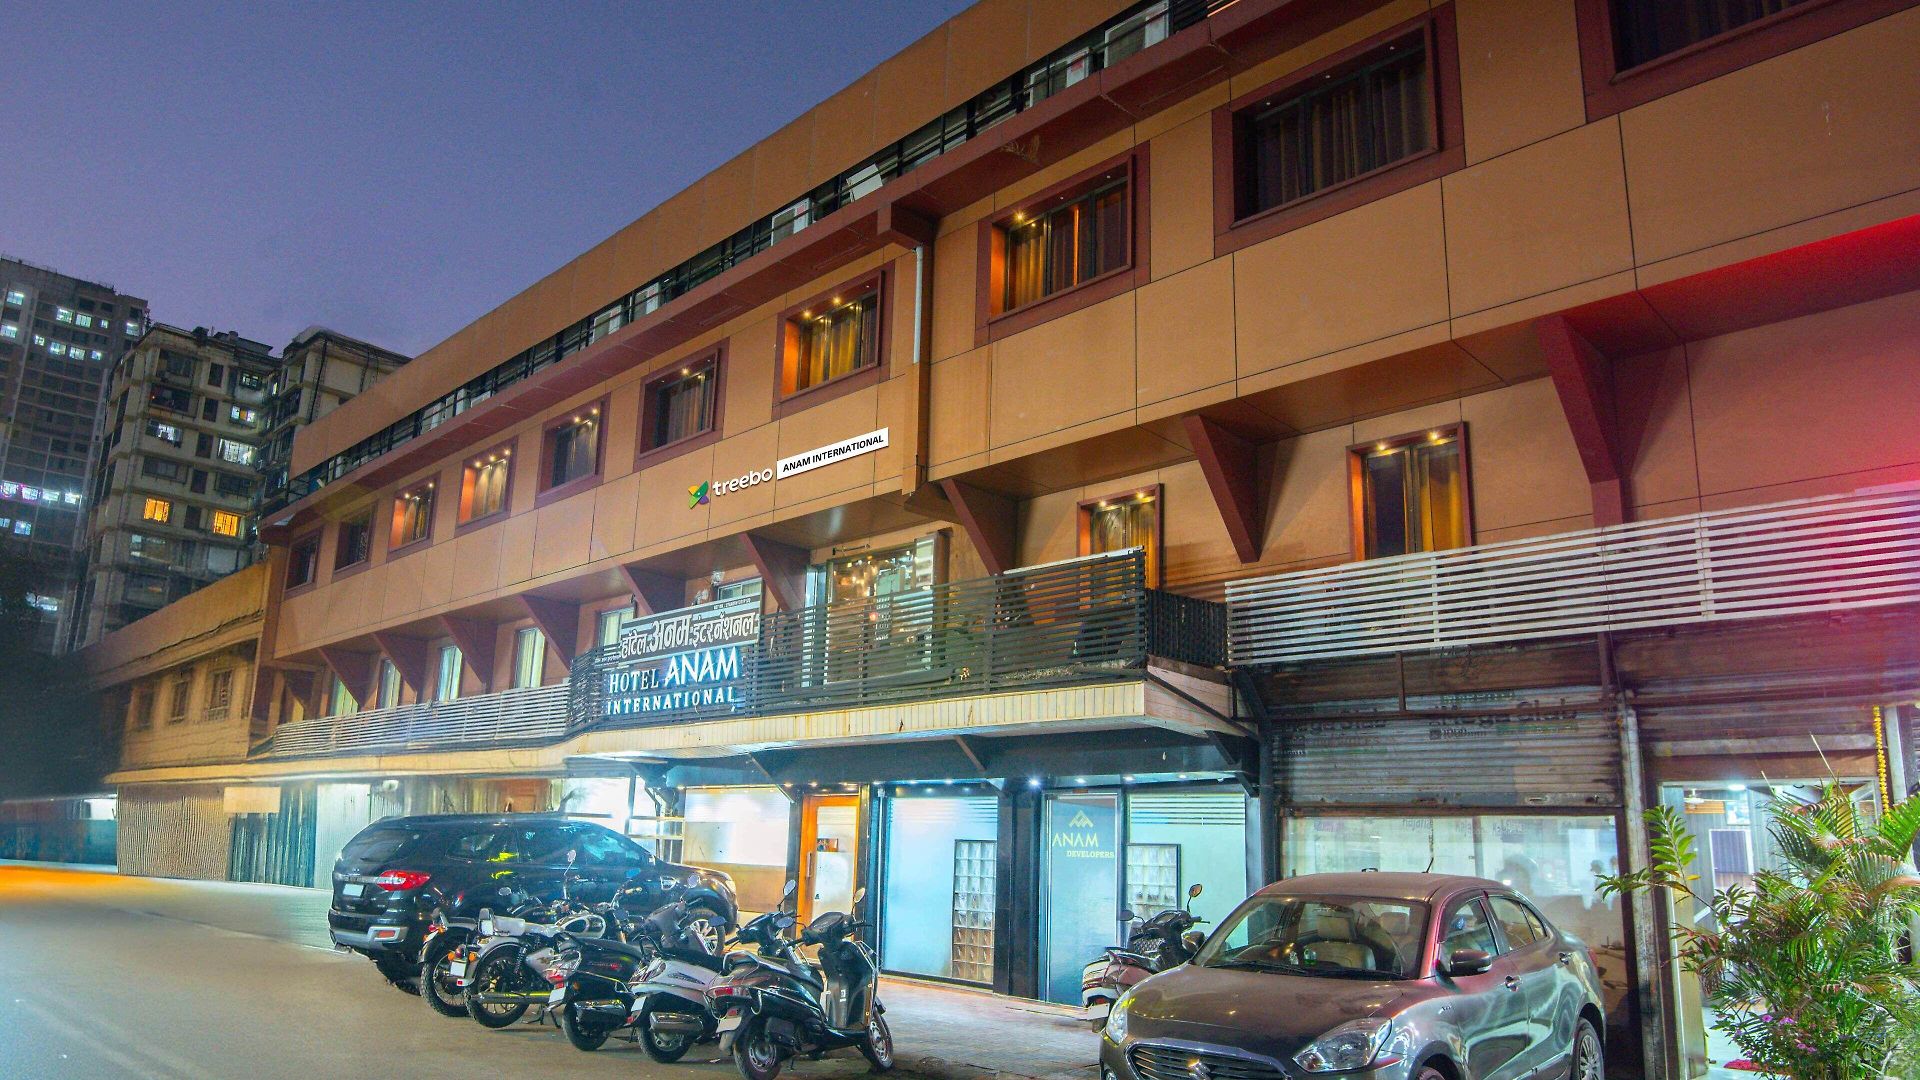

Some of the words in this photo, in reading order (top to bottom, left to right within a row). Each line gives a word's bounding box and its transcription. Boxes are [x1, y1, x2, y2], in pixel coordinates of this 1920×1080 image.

[782, 457, 811, 473] ANAM
[812, 434, 885, 464] INTERNATIONAL
[712, 467, 774, 496] treebo
[609, 668, 660, 694] HOTEL
[664, 646, 738, 687] ANAM
[607, 686, 736, 716] INTERNATIONAL
[1052, 832, 1099, 848] ANAM
[1066, 850, 1115, 859] DEVELOPERS
